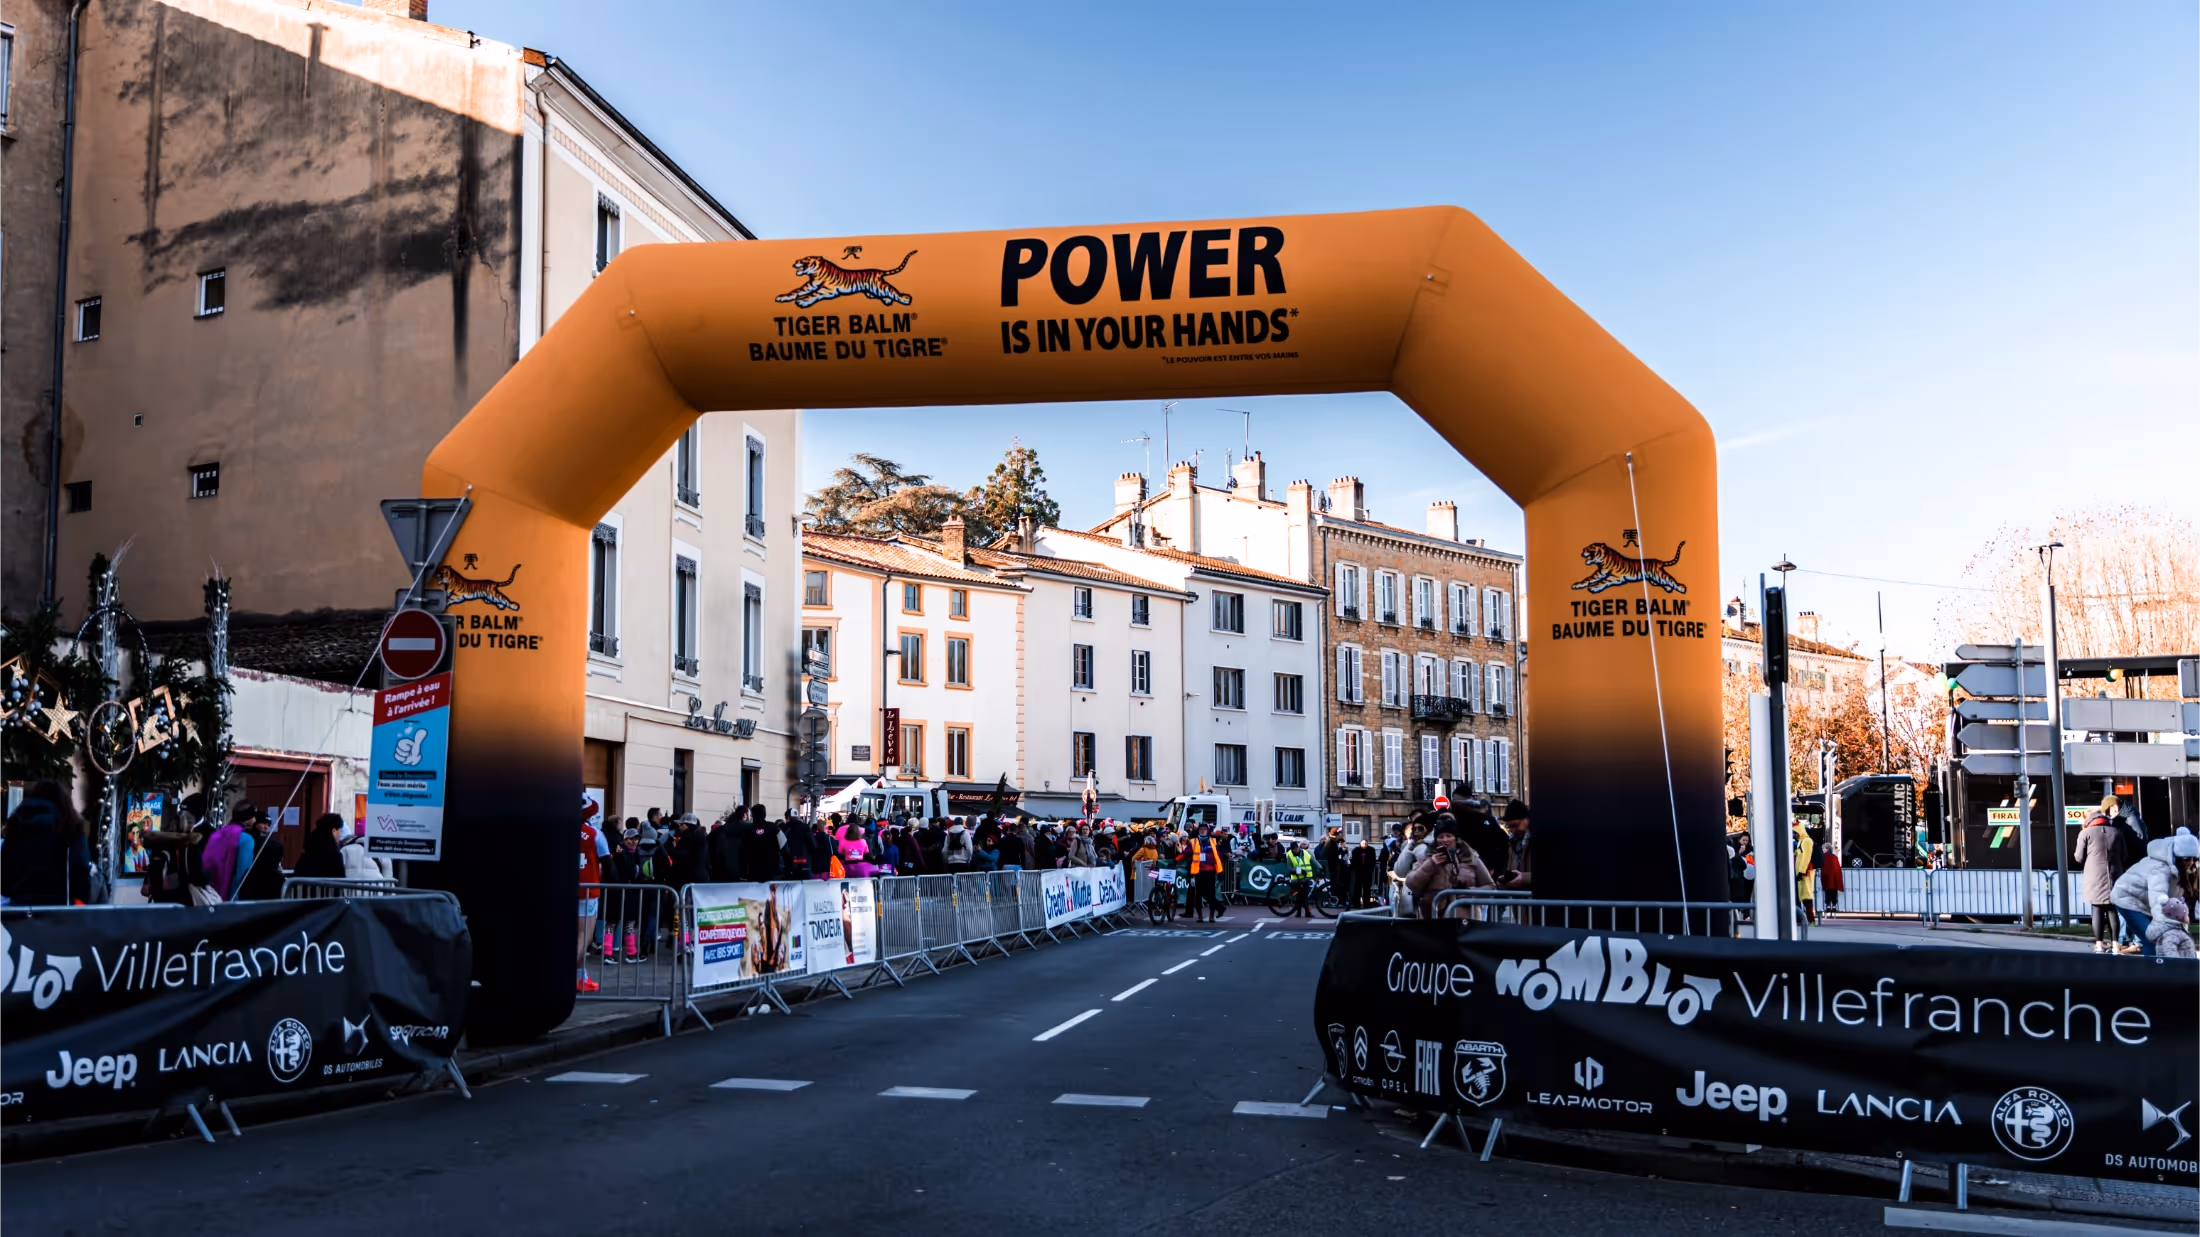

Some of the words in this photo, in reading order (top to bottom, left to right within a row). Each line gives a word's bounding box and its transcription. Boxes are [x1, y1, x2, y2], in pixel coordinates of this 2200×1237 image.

[1001, 226, 1287, 307] POWER
[774, 316, 840, 336] TIGER
[1001, 320, 1030, 353] IS
[1037, 318, 1071, 352] IN
[1076, 314, 1166, 350] YOUR
[749, 341, 828, 361] BAUME
[835, 341, 866, 359] DU
[1176, 355, 1212, 364] POUVOIR
[1571, 599, 1628, 617] TIGER
[459, 633, 481, 648] DU
[1552, 621, 1614, 640] BAUME
[1622, 620, 1650, 636] DU
[385, 689, 415, 704] Rampe
[417, 685, 423, 695] à
[424, 682, 440, 693] eau
[387, 707, 393, 717] à
[394, 697, 430, 715] l'arrivée
[1992, 812, 2021, 820] FIRAL
[808, 918, 842, 941] TONDEUR
[92, 931, 345, 992] Villefranche
[1387, 952, 1474, 1005] Groupe
[1733, 972, 2151, 1045] Villefranche
[286, 1021, 310, 1050] ROMEO
[159, 1040, 252, 1071] LANCIA
[1458, 1043, 1501, 1053] ABARTH
[46, 1050, 137, 1089] Jeep
[323, 1064, 333, 1075] DS
[335, 1058, 384, 1074] AUTOMOBILES
[1415, 1039, 1442, 1096] FIAT
[1381, 1078, 1408, 1093] OPEL
[1676, 1070, 1788, 1123] Jeep
[1527, 1092, 1653, 1114] LEAPMOTOR
[1816, 1089, 1962, 1126] LANCIA
[1995, 1093, 2022, 1121] ALFA
[2028, 1090, 2070, 1127] ROMEO
[2105, 1153, 2123, 1167] DS
[2128, 1156, 2200, 1174] AUTOMOB
